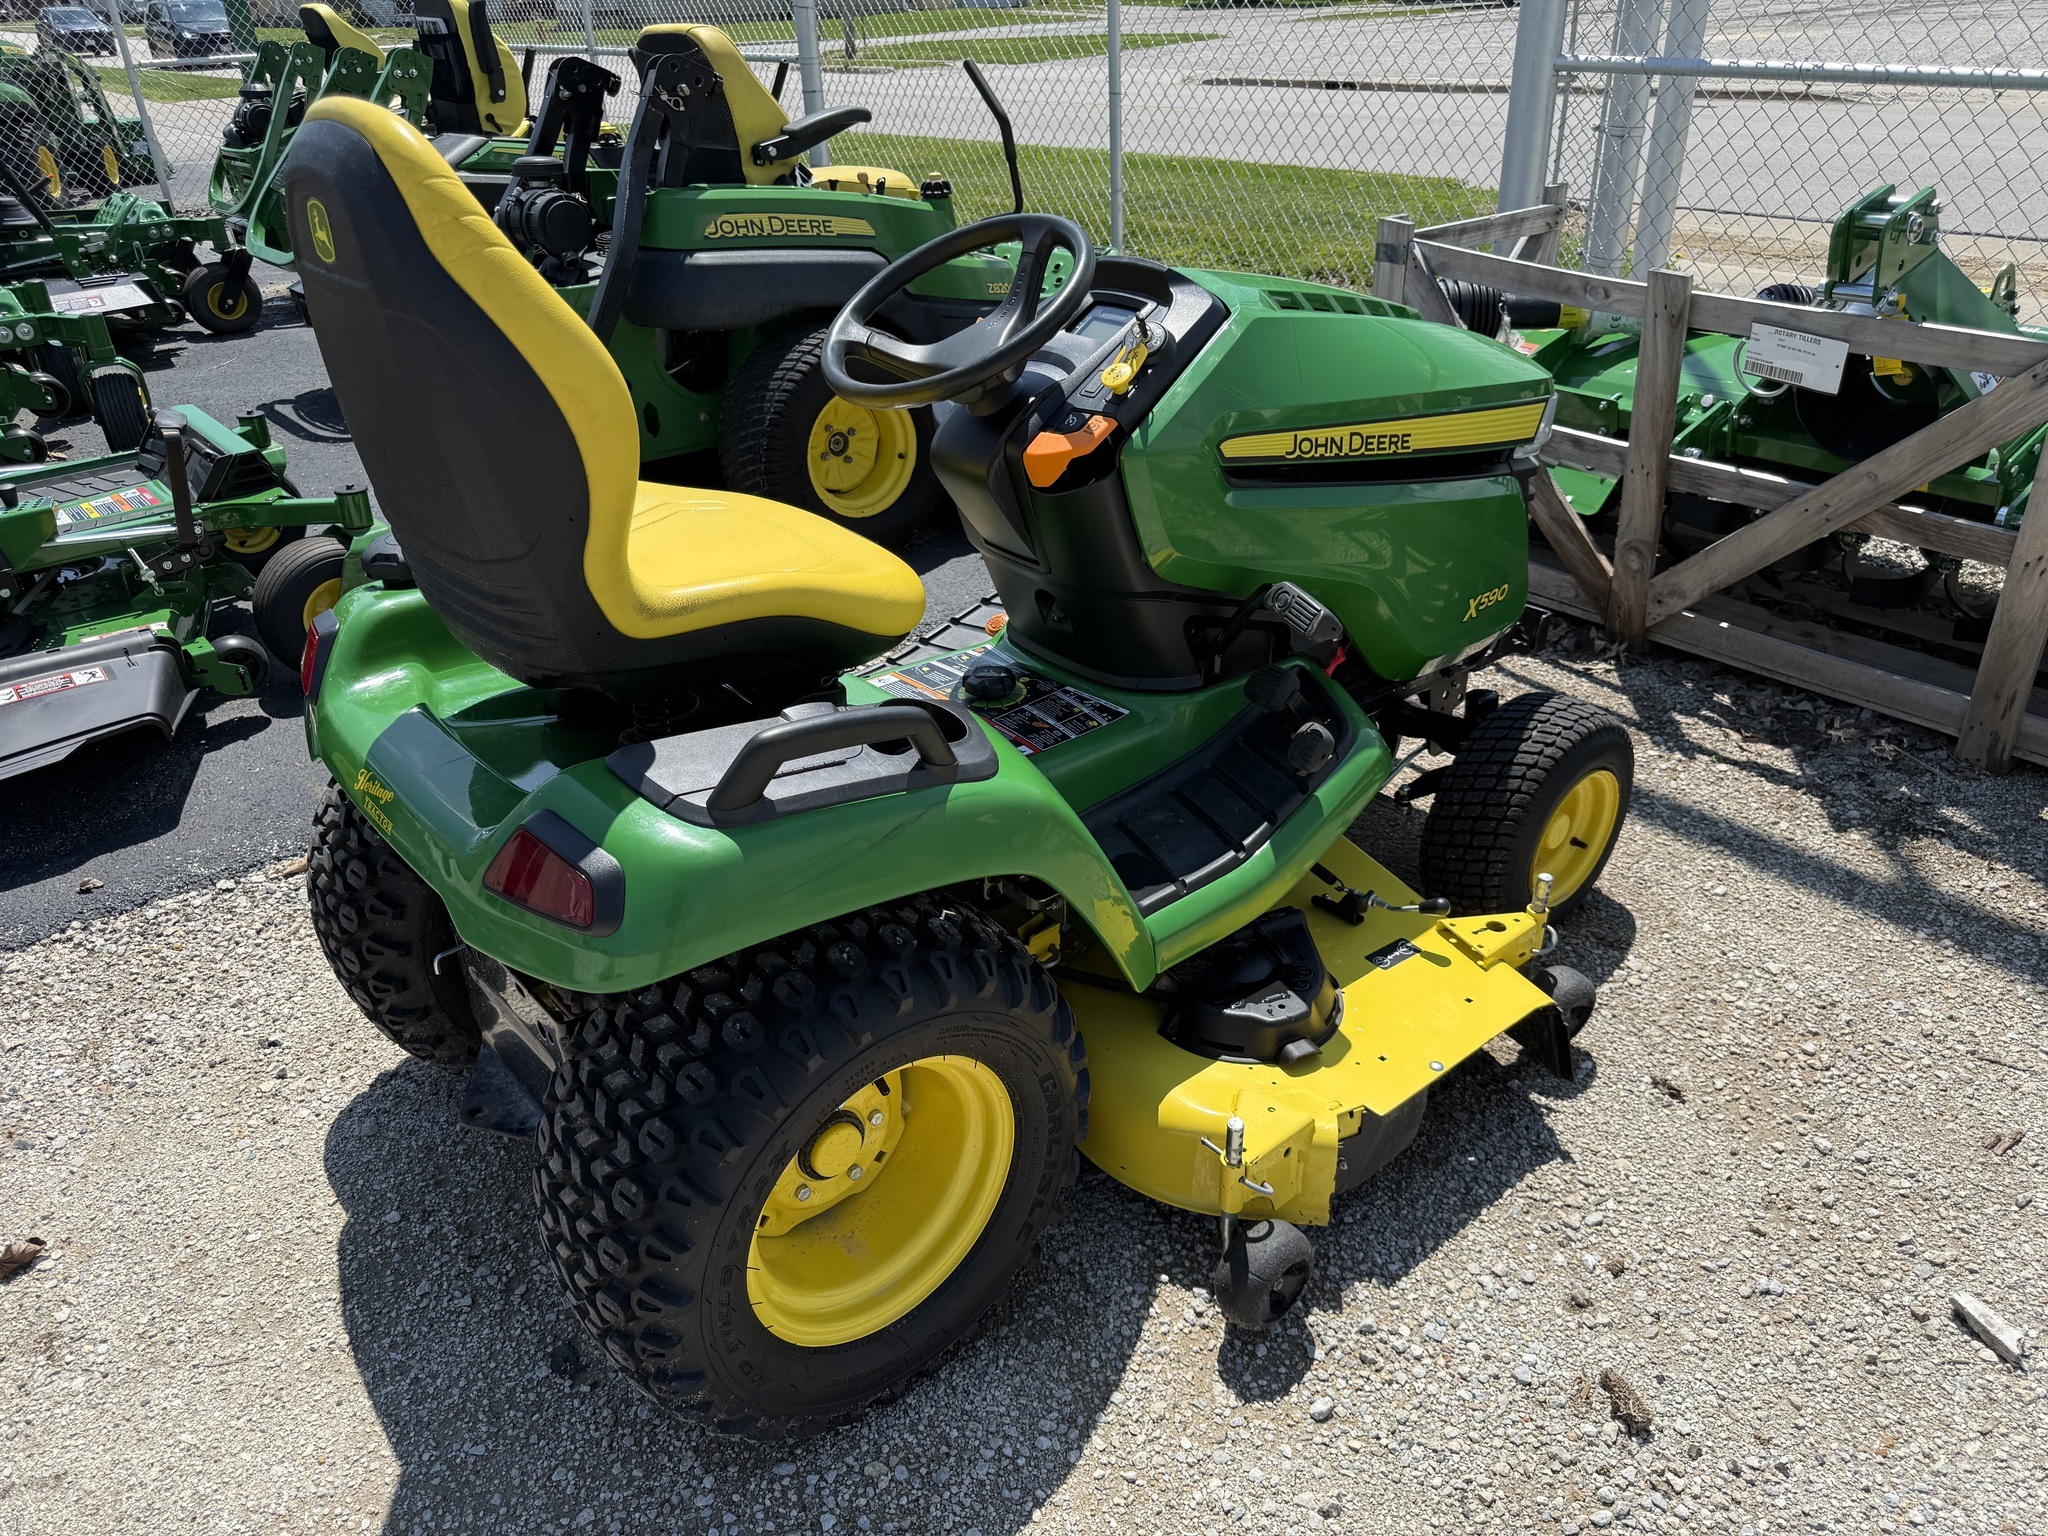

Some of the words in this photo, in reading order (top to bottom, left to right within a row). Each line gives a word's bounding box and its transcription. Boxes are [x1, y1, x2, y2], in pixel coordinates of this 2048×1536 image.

[707, 215, 767, 238] JOHN
[768, 215, 836, 235] DEERE
[986, 282, 1013, 294] Z820
[1774, 328, 1798, 340] ROTARY
[1798, 334, 1822, 346] TILLERS
[1284, 433, 1344, 458] JOHN
[1347, 431, 1413, 456] DEERE
[1462, 583, 1509, 623] X590
[354, 769, 394, 804] Heritage
[364, 797, 393, 834] TRACTOR
[1015, 1072, 1063, 1246] CARLISLE
[718, 1264, 745, 1355] FIELD
